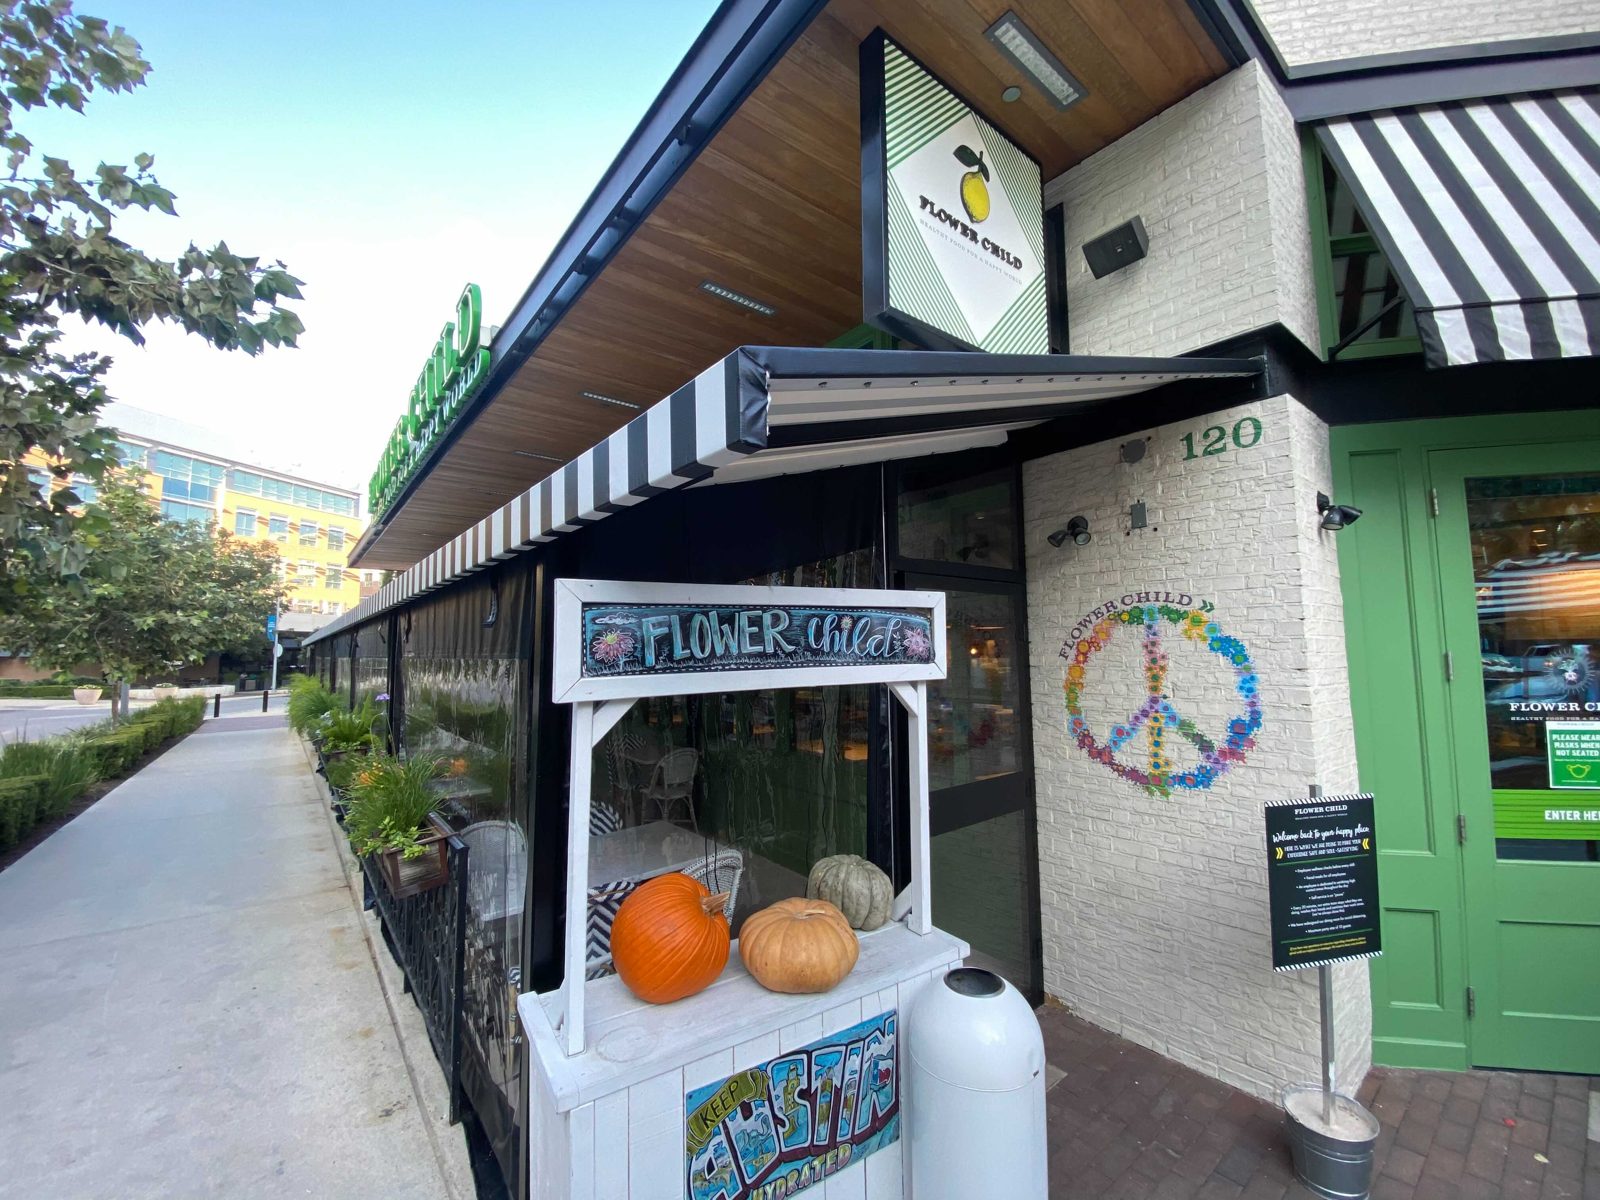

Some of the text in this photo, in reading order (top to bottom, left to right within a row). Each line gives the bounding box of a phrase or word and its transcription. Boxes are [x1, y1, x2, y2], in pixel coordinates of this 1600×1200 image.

[919, 195, 1023, 270] FLOWER CHILD
[406, 282, 482, 442] CHILD
[1181, 416, 1263, 461] 120
[641, 609, 796, 667] FLOWER
[1058, 591, 1193, 661] FLOWER CHILD
[1509, 702, 1581, 712] FLOWER
[1272, 830, 1300, 843] Welcome
[1300, 829, 1314, 839] back
[1336, 826, 1353, 838] happy
[1294, 804, 1348, 815] FLOWER CHILD
[1544, 810, 1600, 820] ENTER HE
[689, 1015, 896, 1200] AUSTIN
[700, 1080, 740, 1131] KEEP
[751, 1143, 853, 1200] HYDRATED
